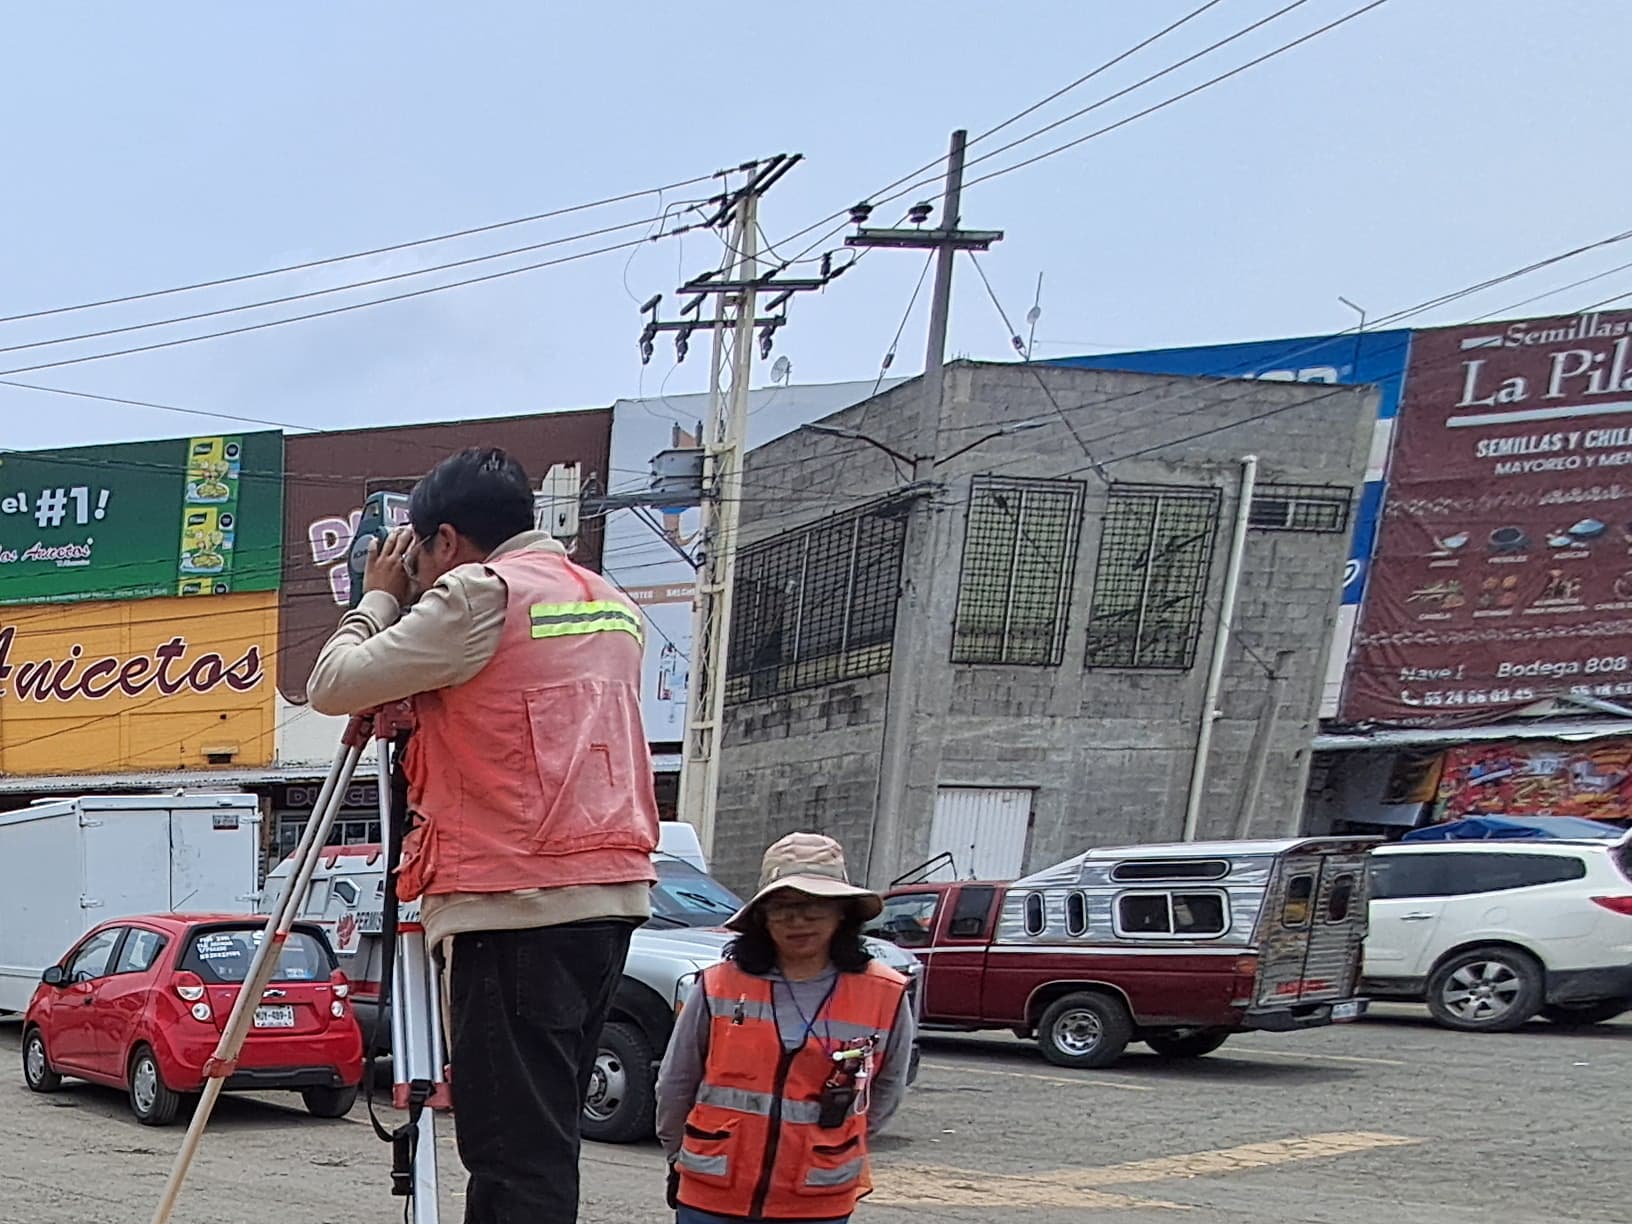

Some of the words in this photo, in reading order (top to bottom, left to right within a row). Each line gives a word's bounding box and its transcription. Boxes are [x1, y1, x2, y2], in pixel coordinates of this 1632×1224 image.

[1454, 359, 1530, 408] La
[1476, 433, 1564, 458] SEMILLAS
[1567, 431, 1581, 450] Y
[1494, 455, 1582, 476] MAYOREO
[1586, 454, 1599, 468] Y
[1, 492, 29, 514] el
[34, 486, 110, 527] #1!
[1496, 660, 1579, 681] Bodega
[1584, 655, 1628, 673] 808
